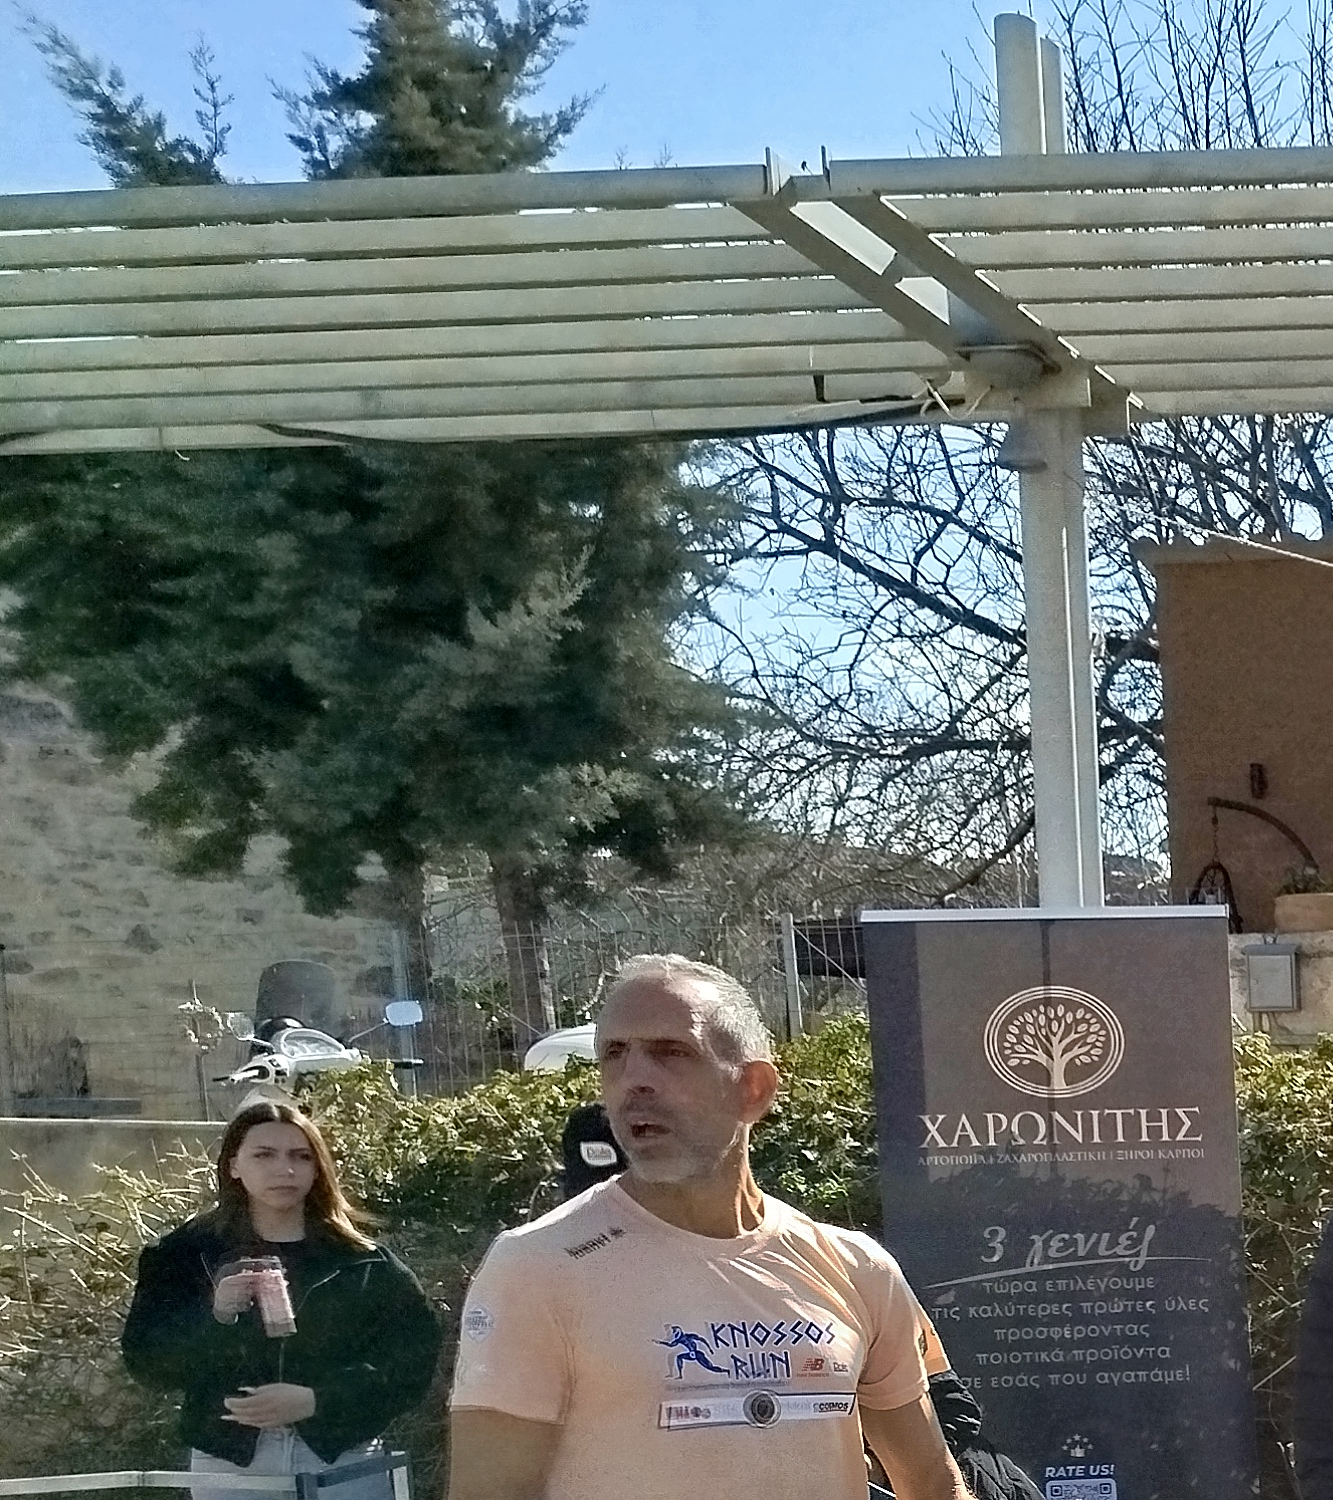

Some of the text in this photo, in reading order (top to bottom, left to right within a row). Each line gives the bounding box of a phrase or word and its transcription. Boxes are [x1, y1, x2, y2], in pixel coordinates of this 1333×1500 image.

[918, 1106, 1203, 1149] ΧΑΡΩΝΙΤΗΣ
[1157, 1147, 1205, 1160] ΚΑΡΠΟΙ
[980, 1225, 1008, 1264] 3
[982, 1275, 1156, 1296] τώρα επιλέγουμε
[931, 1296, 1210, 1321] τις καλύτερες πρώτες ύλες
[709, 1319, 836, 1349] KNOSSOS
[993, 1321, 1151, 1343] προσφέροντας
[730, 1350, 791, 1380] RUN
[975, 1343, 1172, 1366] ποιοτικά προϊόντα
[989, 1373, 1041, 1391] εσάς
[1048, 1372, 1088, 1386] που
[1095, 1364, 1192, 1388] αγαπάμε!
[1045, 1463, 1116, 1478] RATE US!
